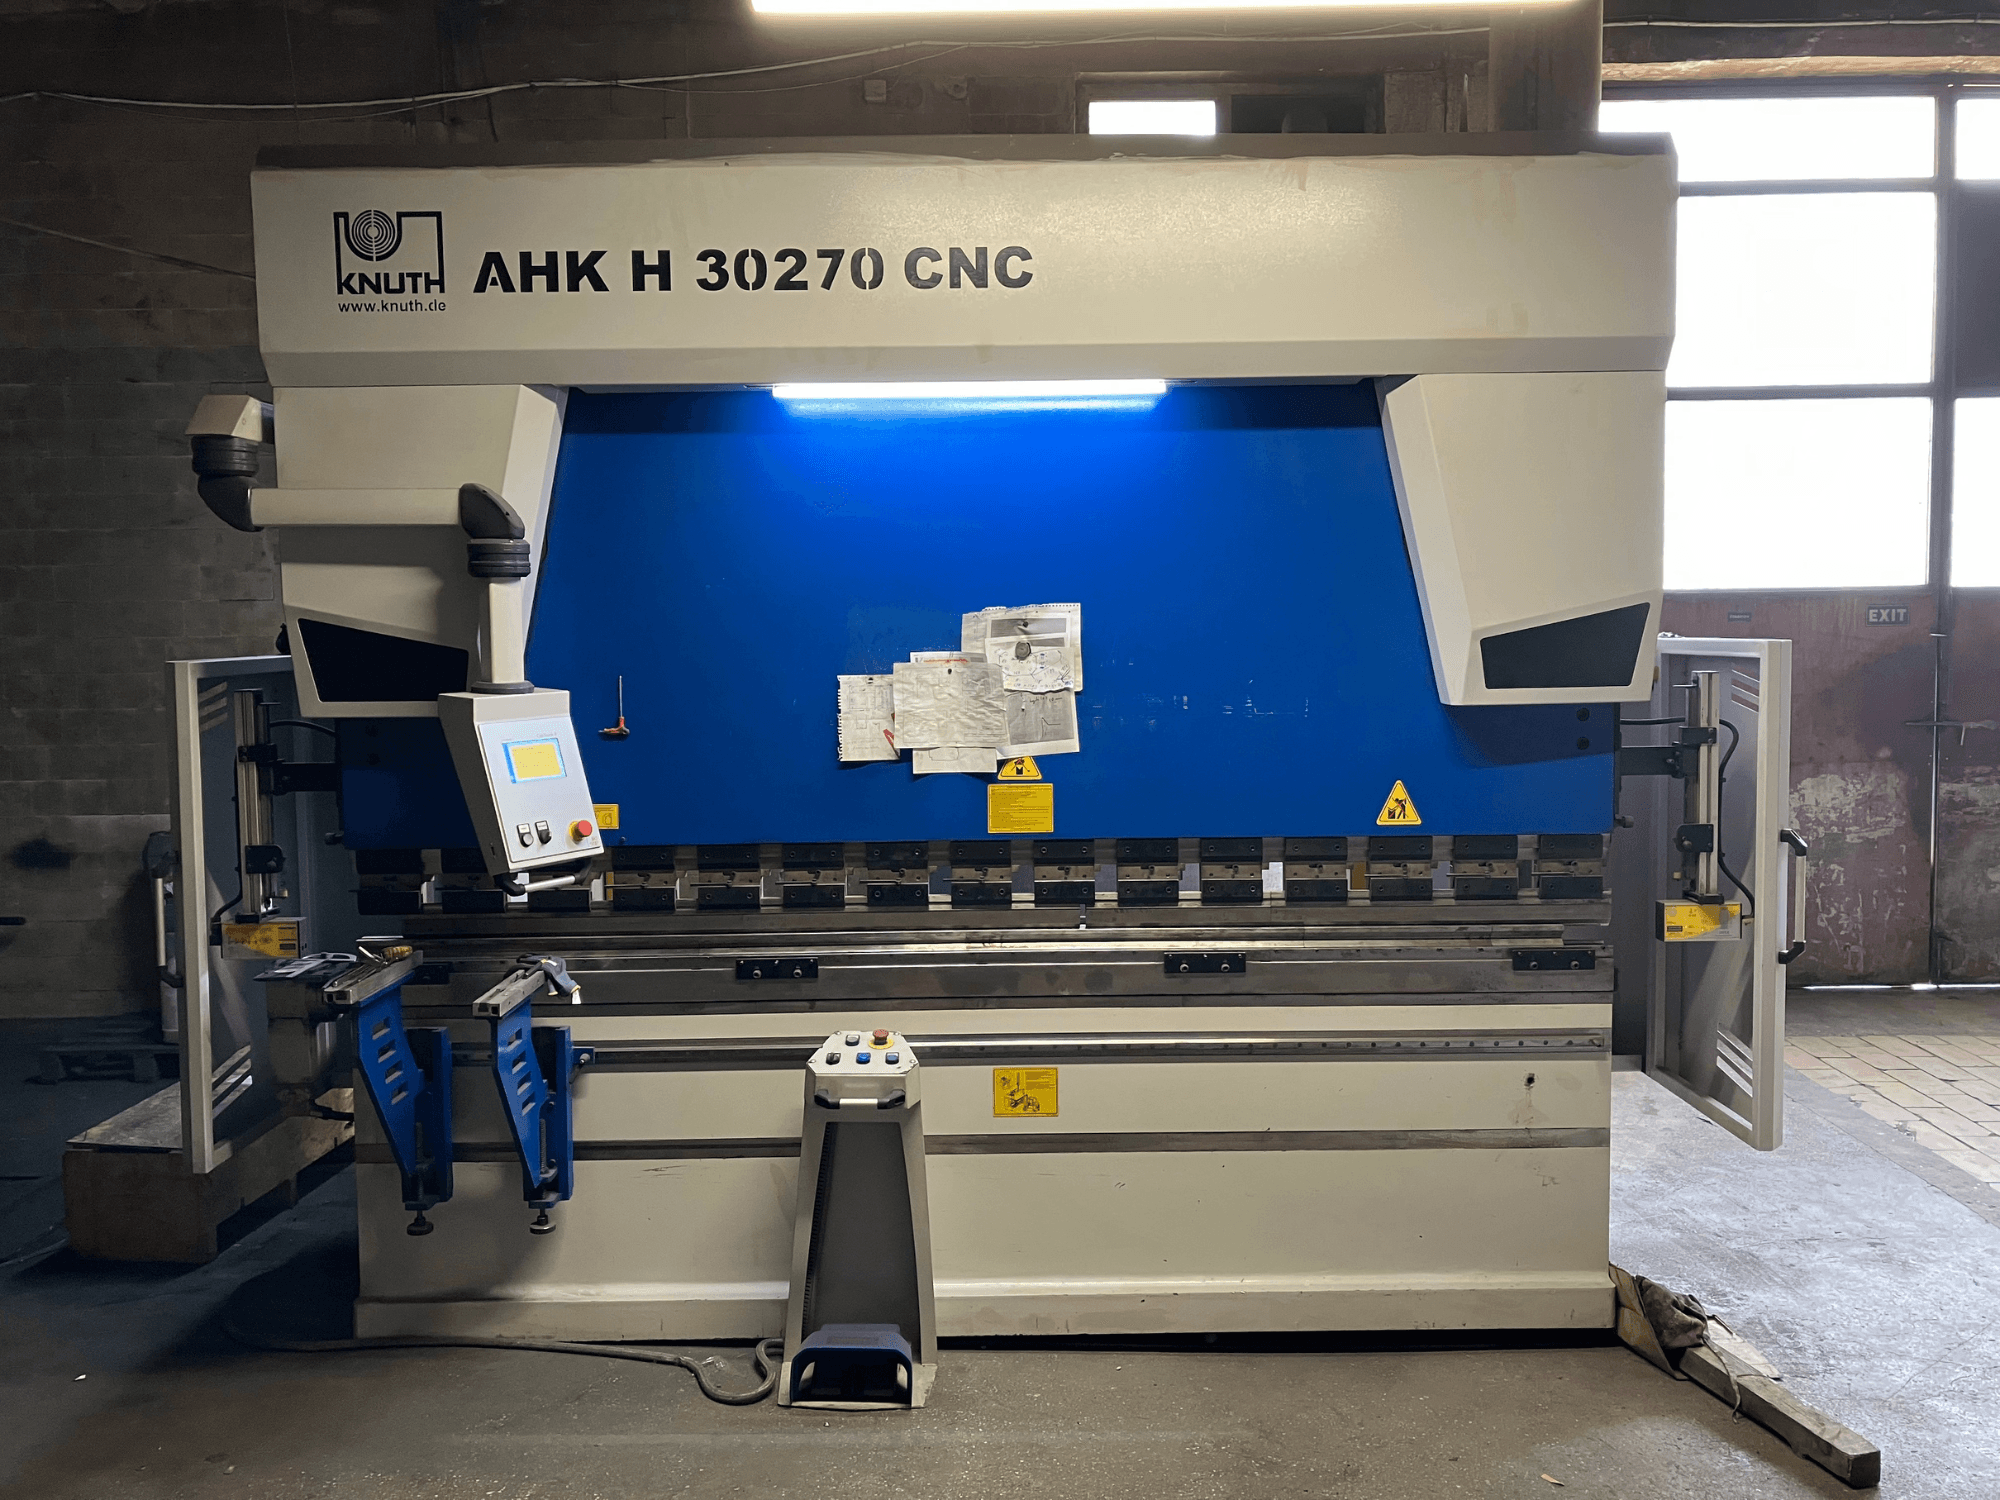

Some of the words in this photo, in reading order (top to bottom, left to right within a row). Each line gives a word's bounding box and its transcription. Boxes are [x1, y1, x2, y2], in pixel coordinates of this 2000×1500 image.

[473, 250, 610, 293] AHK
[631, 249, 672, 292] H
[695, 247, 885, 292] 30270
[904, 246, 1033, 289] CNC
[336, 271, 446, 295] KNUTH
[337, 299, 447, 313] www.knuth.de
[1868, 608, 1907, 622] EXIT
